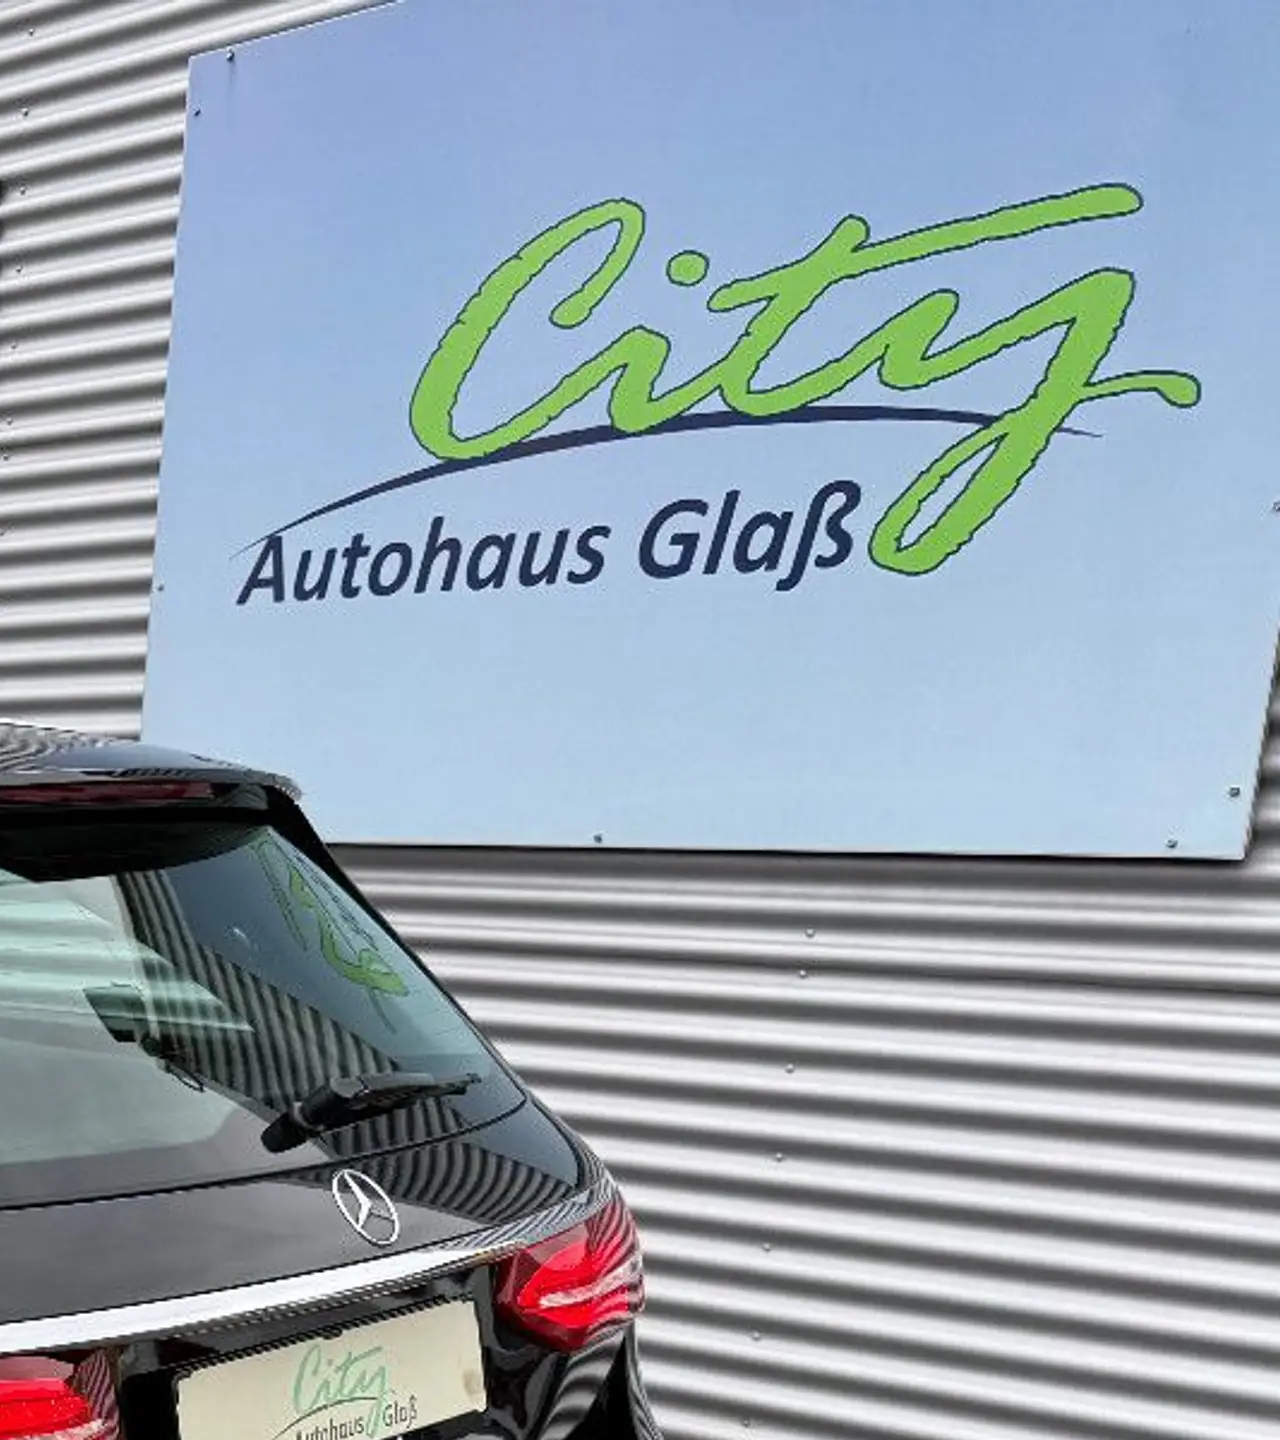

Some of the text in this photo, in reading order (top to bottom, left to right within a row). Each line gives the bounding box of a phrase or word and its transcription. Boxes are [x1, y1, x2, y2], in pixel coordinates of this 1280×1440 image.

[409, 183, 1202, 576] City
[235, 478, 862, 606] Autohaus Glaß
[293, 1344, 388, 1438] City
[382, 1394, 418, 1429] Glaß
